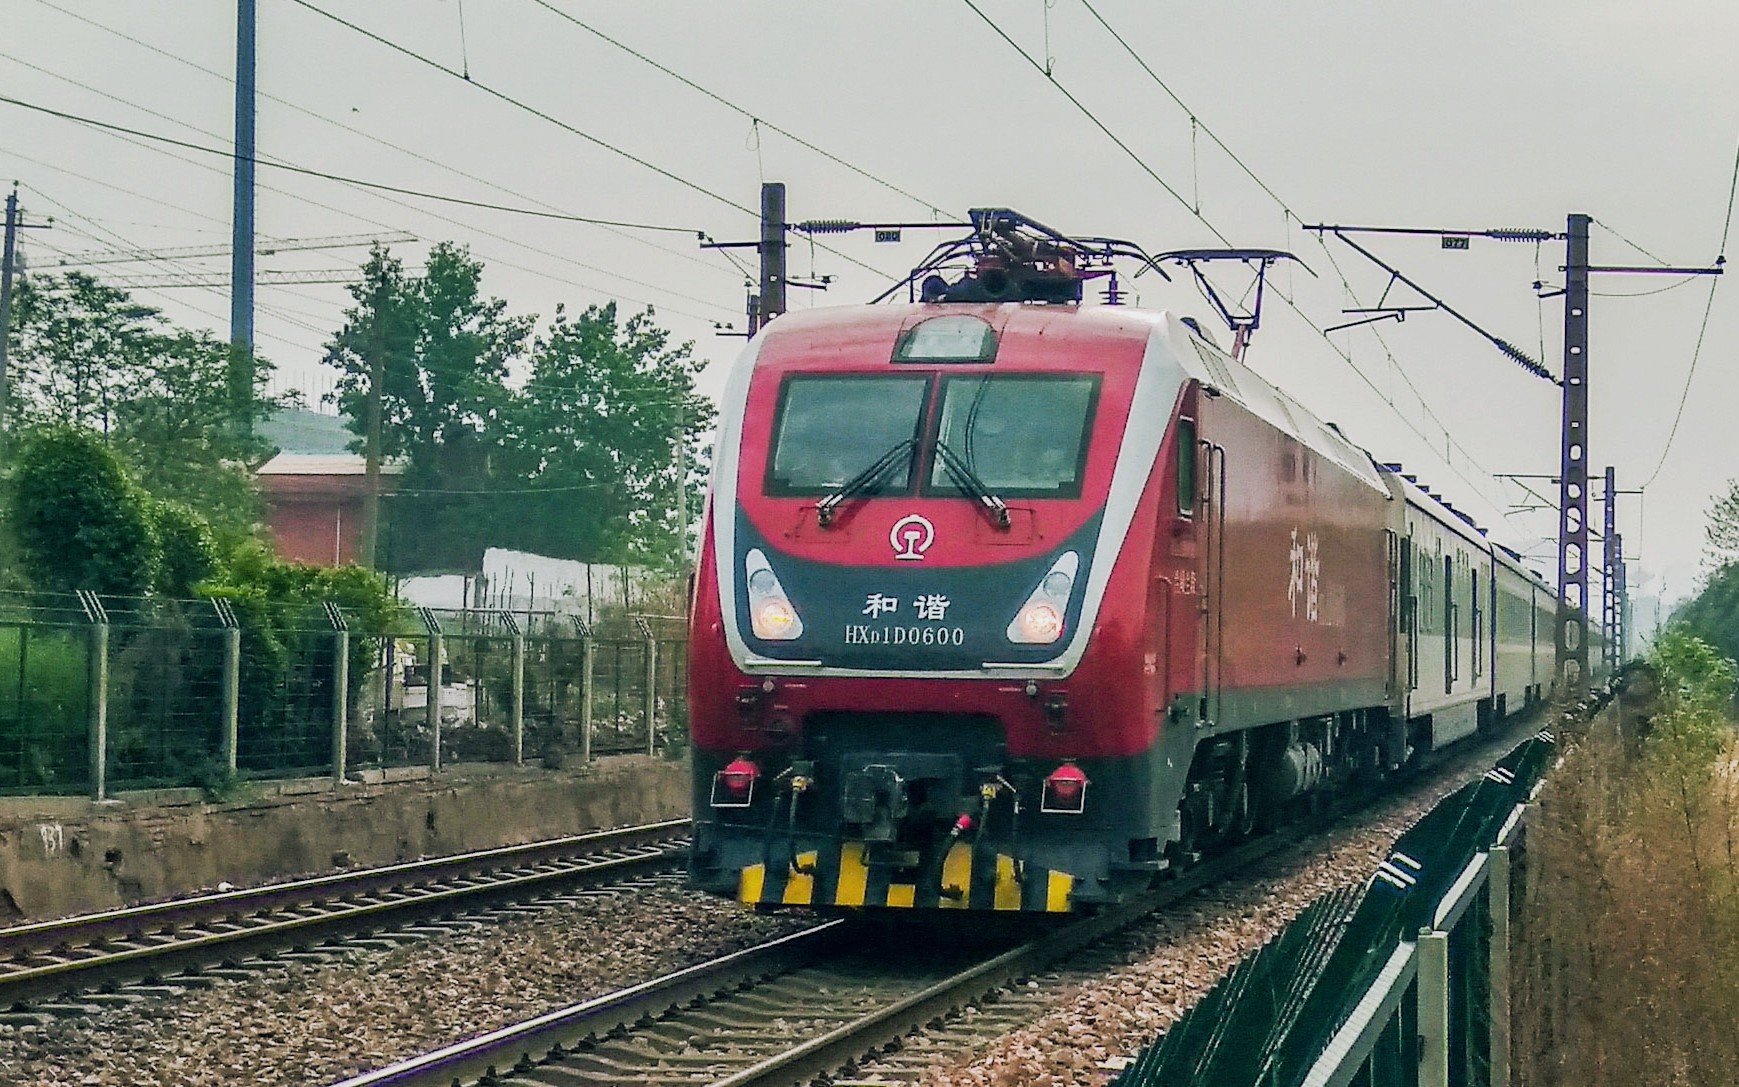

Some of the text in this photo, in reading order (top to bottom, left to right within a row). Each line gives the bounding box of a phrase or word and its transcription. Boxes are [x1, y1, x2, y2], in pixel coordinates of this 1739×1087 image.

[1288, 527, 1320, 623] 和谐
[862, 593, 950, 620] 和谐
[845, 625, 964, 645] HXD1D0600
